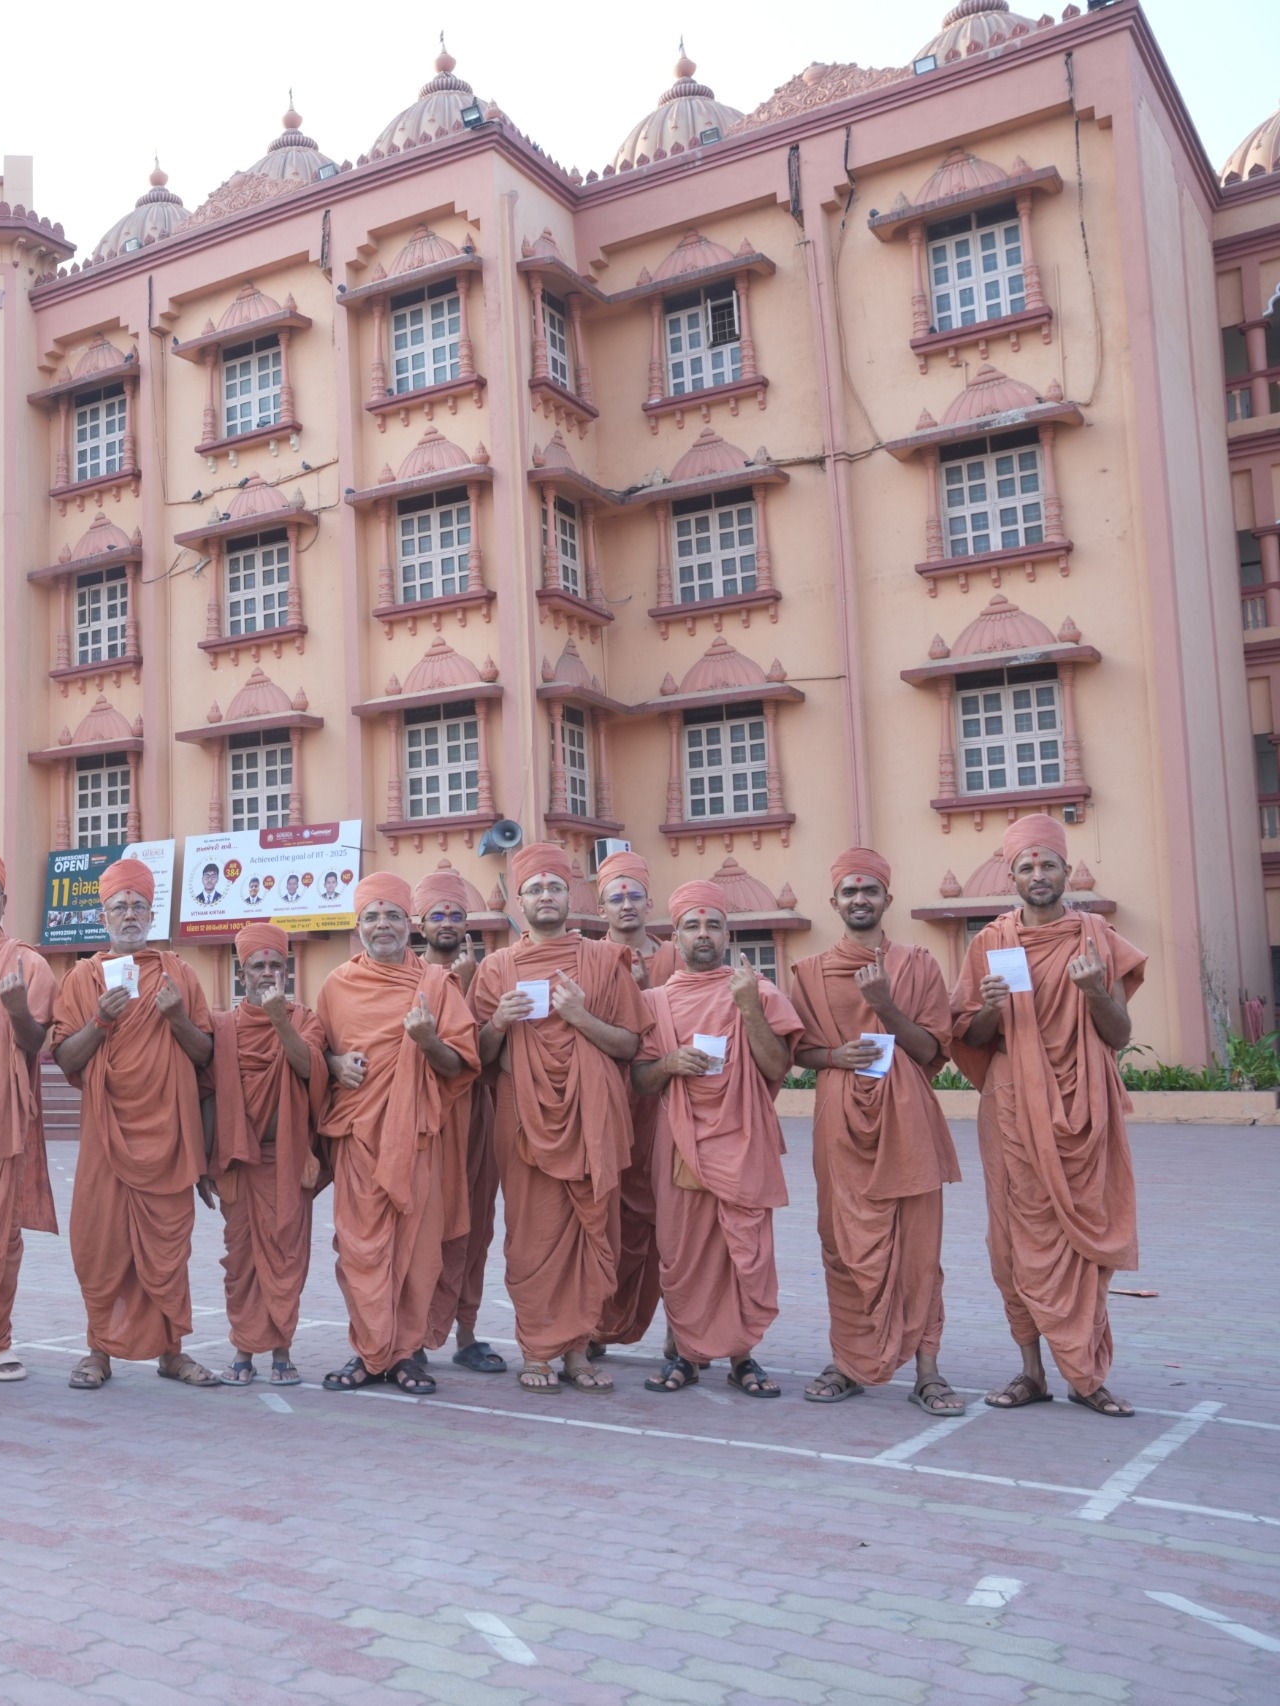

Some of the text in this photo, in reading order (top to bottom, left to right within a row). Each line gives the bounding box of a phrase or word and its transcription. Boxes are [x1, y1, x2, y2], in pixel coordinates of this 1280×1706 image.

[249, 855, 279, 865] Achieved
[279, 854, 291, 862] the
[291, 853, 306, 863] goal
[306, 851, 314, 859] of
[54, 859, 85, 873] OPEN
[225, 868, 240, 878] 384
[51, 877, 70, 907] 11
